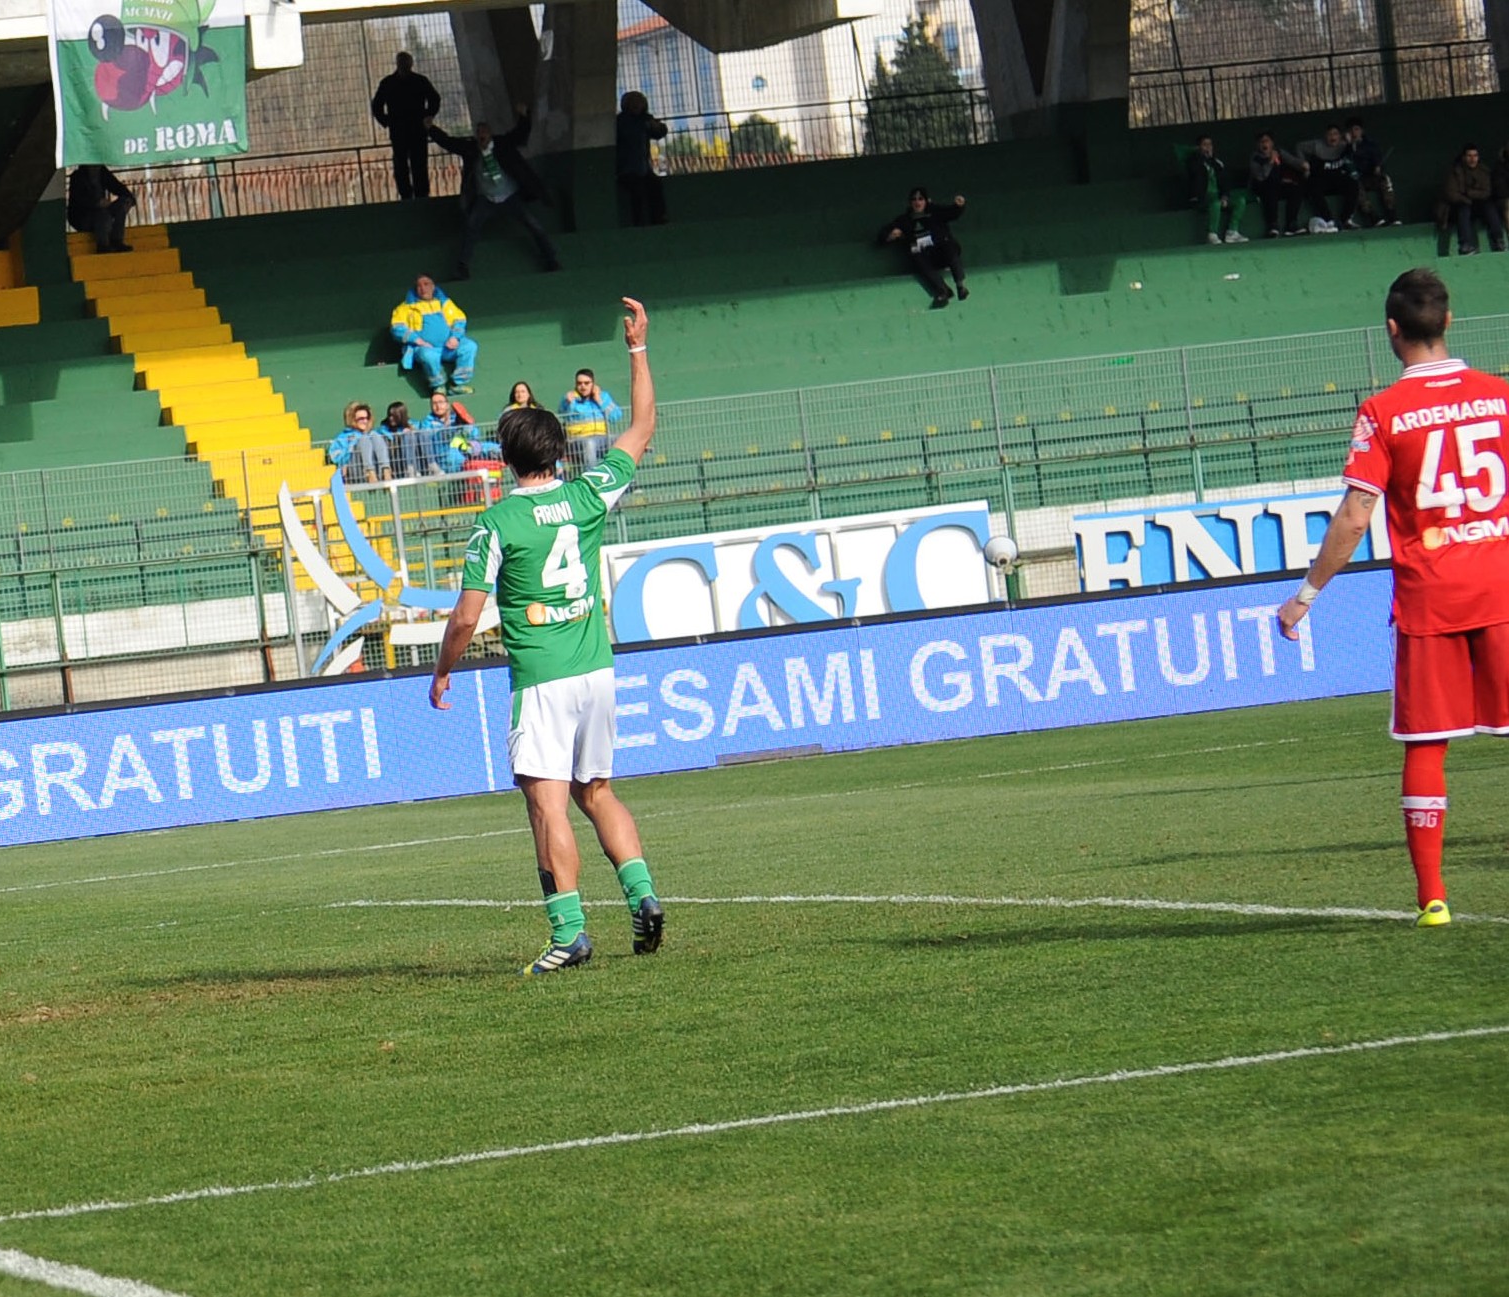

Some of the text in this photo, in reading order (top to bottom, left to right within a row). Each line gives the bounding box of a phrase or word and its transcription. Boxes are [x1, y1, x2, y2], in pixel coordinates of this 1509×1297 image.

[124, 119, 239, 155] DE ROMA
[1391, 398, 1508, 435] ARDEMAGNI
[1415, 420, 1506, 518] 45
[532, 500, 574, 526] ARINI
[1443, 516, 1509, 544] NGM
[541, 524, 588, 599] 4
[612, 512, 989, 644] C&C
[544, 595, 595, 623] NGM
[613, 604, 1317, 750] ESAMI GRATUITI
